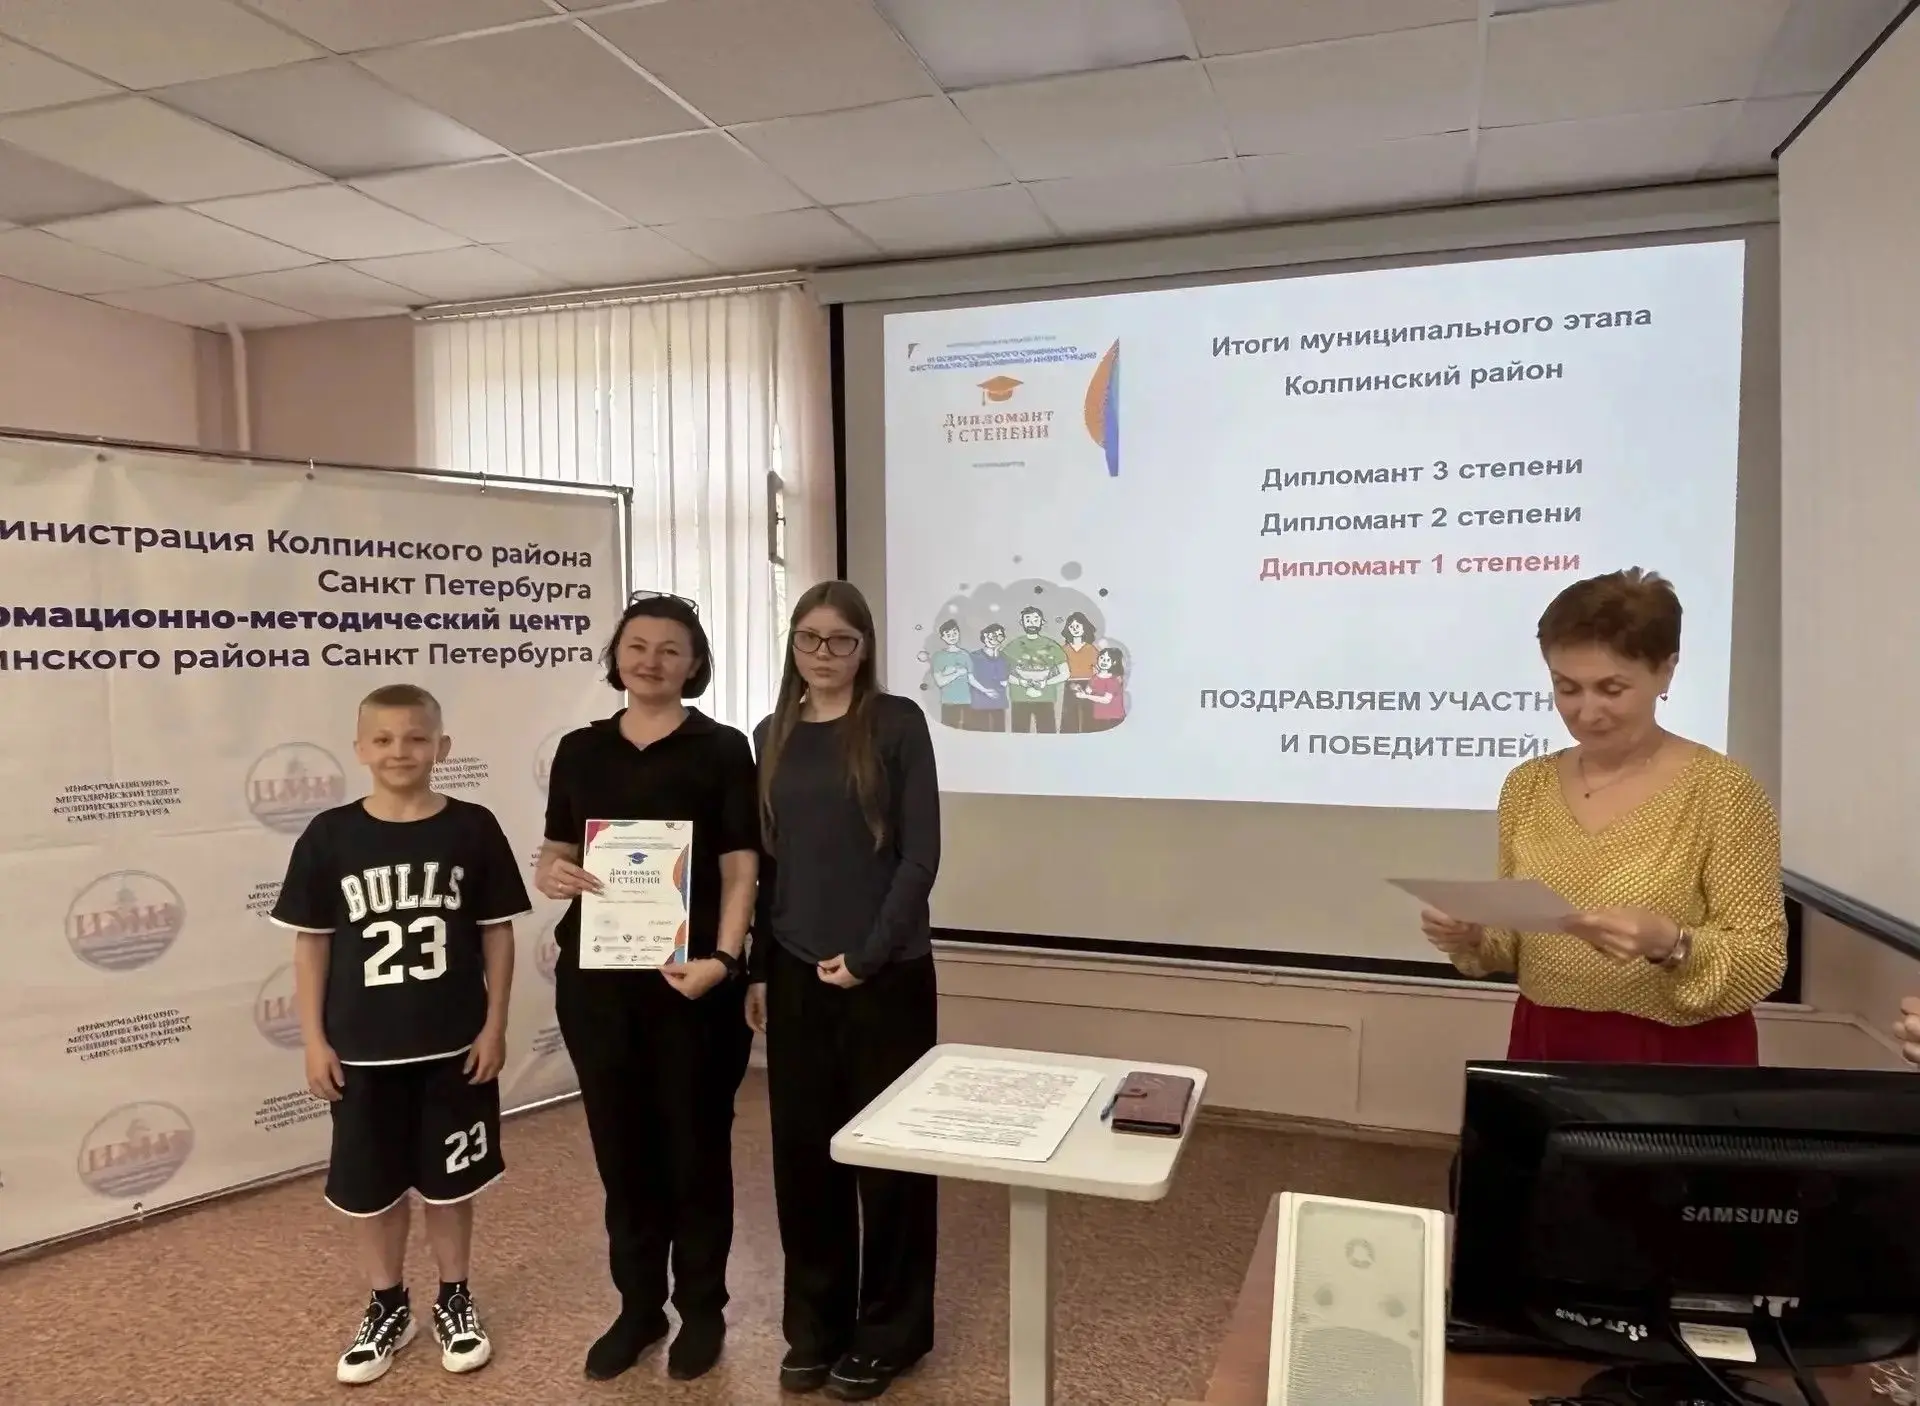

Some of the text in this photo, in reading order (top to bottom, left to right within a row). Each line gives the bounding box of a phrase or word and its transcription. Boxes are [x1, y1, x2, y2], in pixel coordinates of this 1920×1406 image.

[1212, 308, 1652, 357] Итоги муниципального этапа
[1284, 360, 1564, 396] Колпинский район
[943, 411, 1055, 428] Дипломант
[959, 424, 1049, 443] СТЕПЕНИ
[1261, 457, 1584, 492] Дипломант 3 степени
[1260, 505, 1582, 536] Дипломант 2 степени
[267, 529, 482, 562] Колпинского
[492, 542, 592, 568] района
[1259, 552, 1580, 580] Дипломант 1 степени
[318, 569, 592, 602] Санкт Петербурга
[509, 613, 590, 635] центр
[174, 641, 310, 675] района
[321, 643, 419, 667] Санкт
[429, 641, 593, 668] Петербурга
[1200, 689, 1421, 712] ПОЗДРАВЛЯЕМ
[1281, 733, 1299, 753] И
[341, 862, 464, 923] BULLS
[362, 916, 447, 987] 23
[445, 1120, 488, 1174] 23
[1681, 1206, 1799, 1224] SAMSUNG
